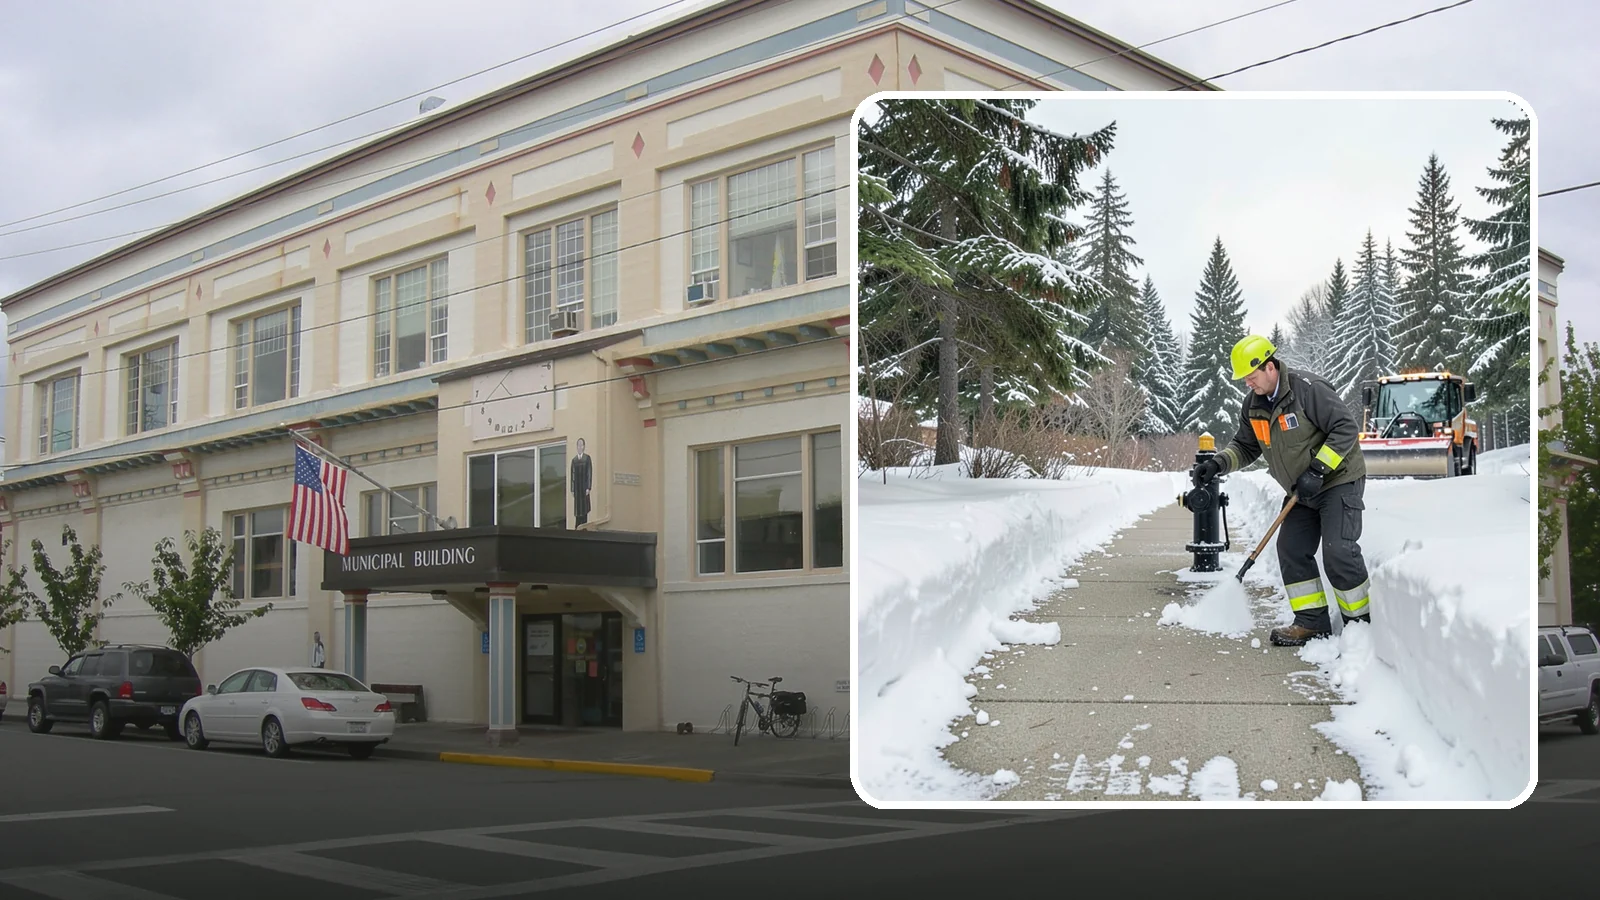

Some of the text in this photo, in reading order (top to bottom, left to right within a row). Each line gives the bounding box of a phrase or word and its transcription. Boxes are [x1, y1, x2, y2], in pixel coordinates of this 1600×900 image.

[488, 418, 492, 426] 9
[529, 414, 533, 422] 3
[495, 424, 500, 432] 10
[521, 420, 525, 428] 2
[507, 425, 513, 433] 12
[342, 546, 475, 572] MUNICIPAL BUILDING
